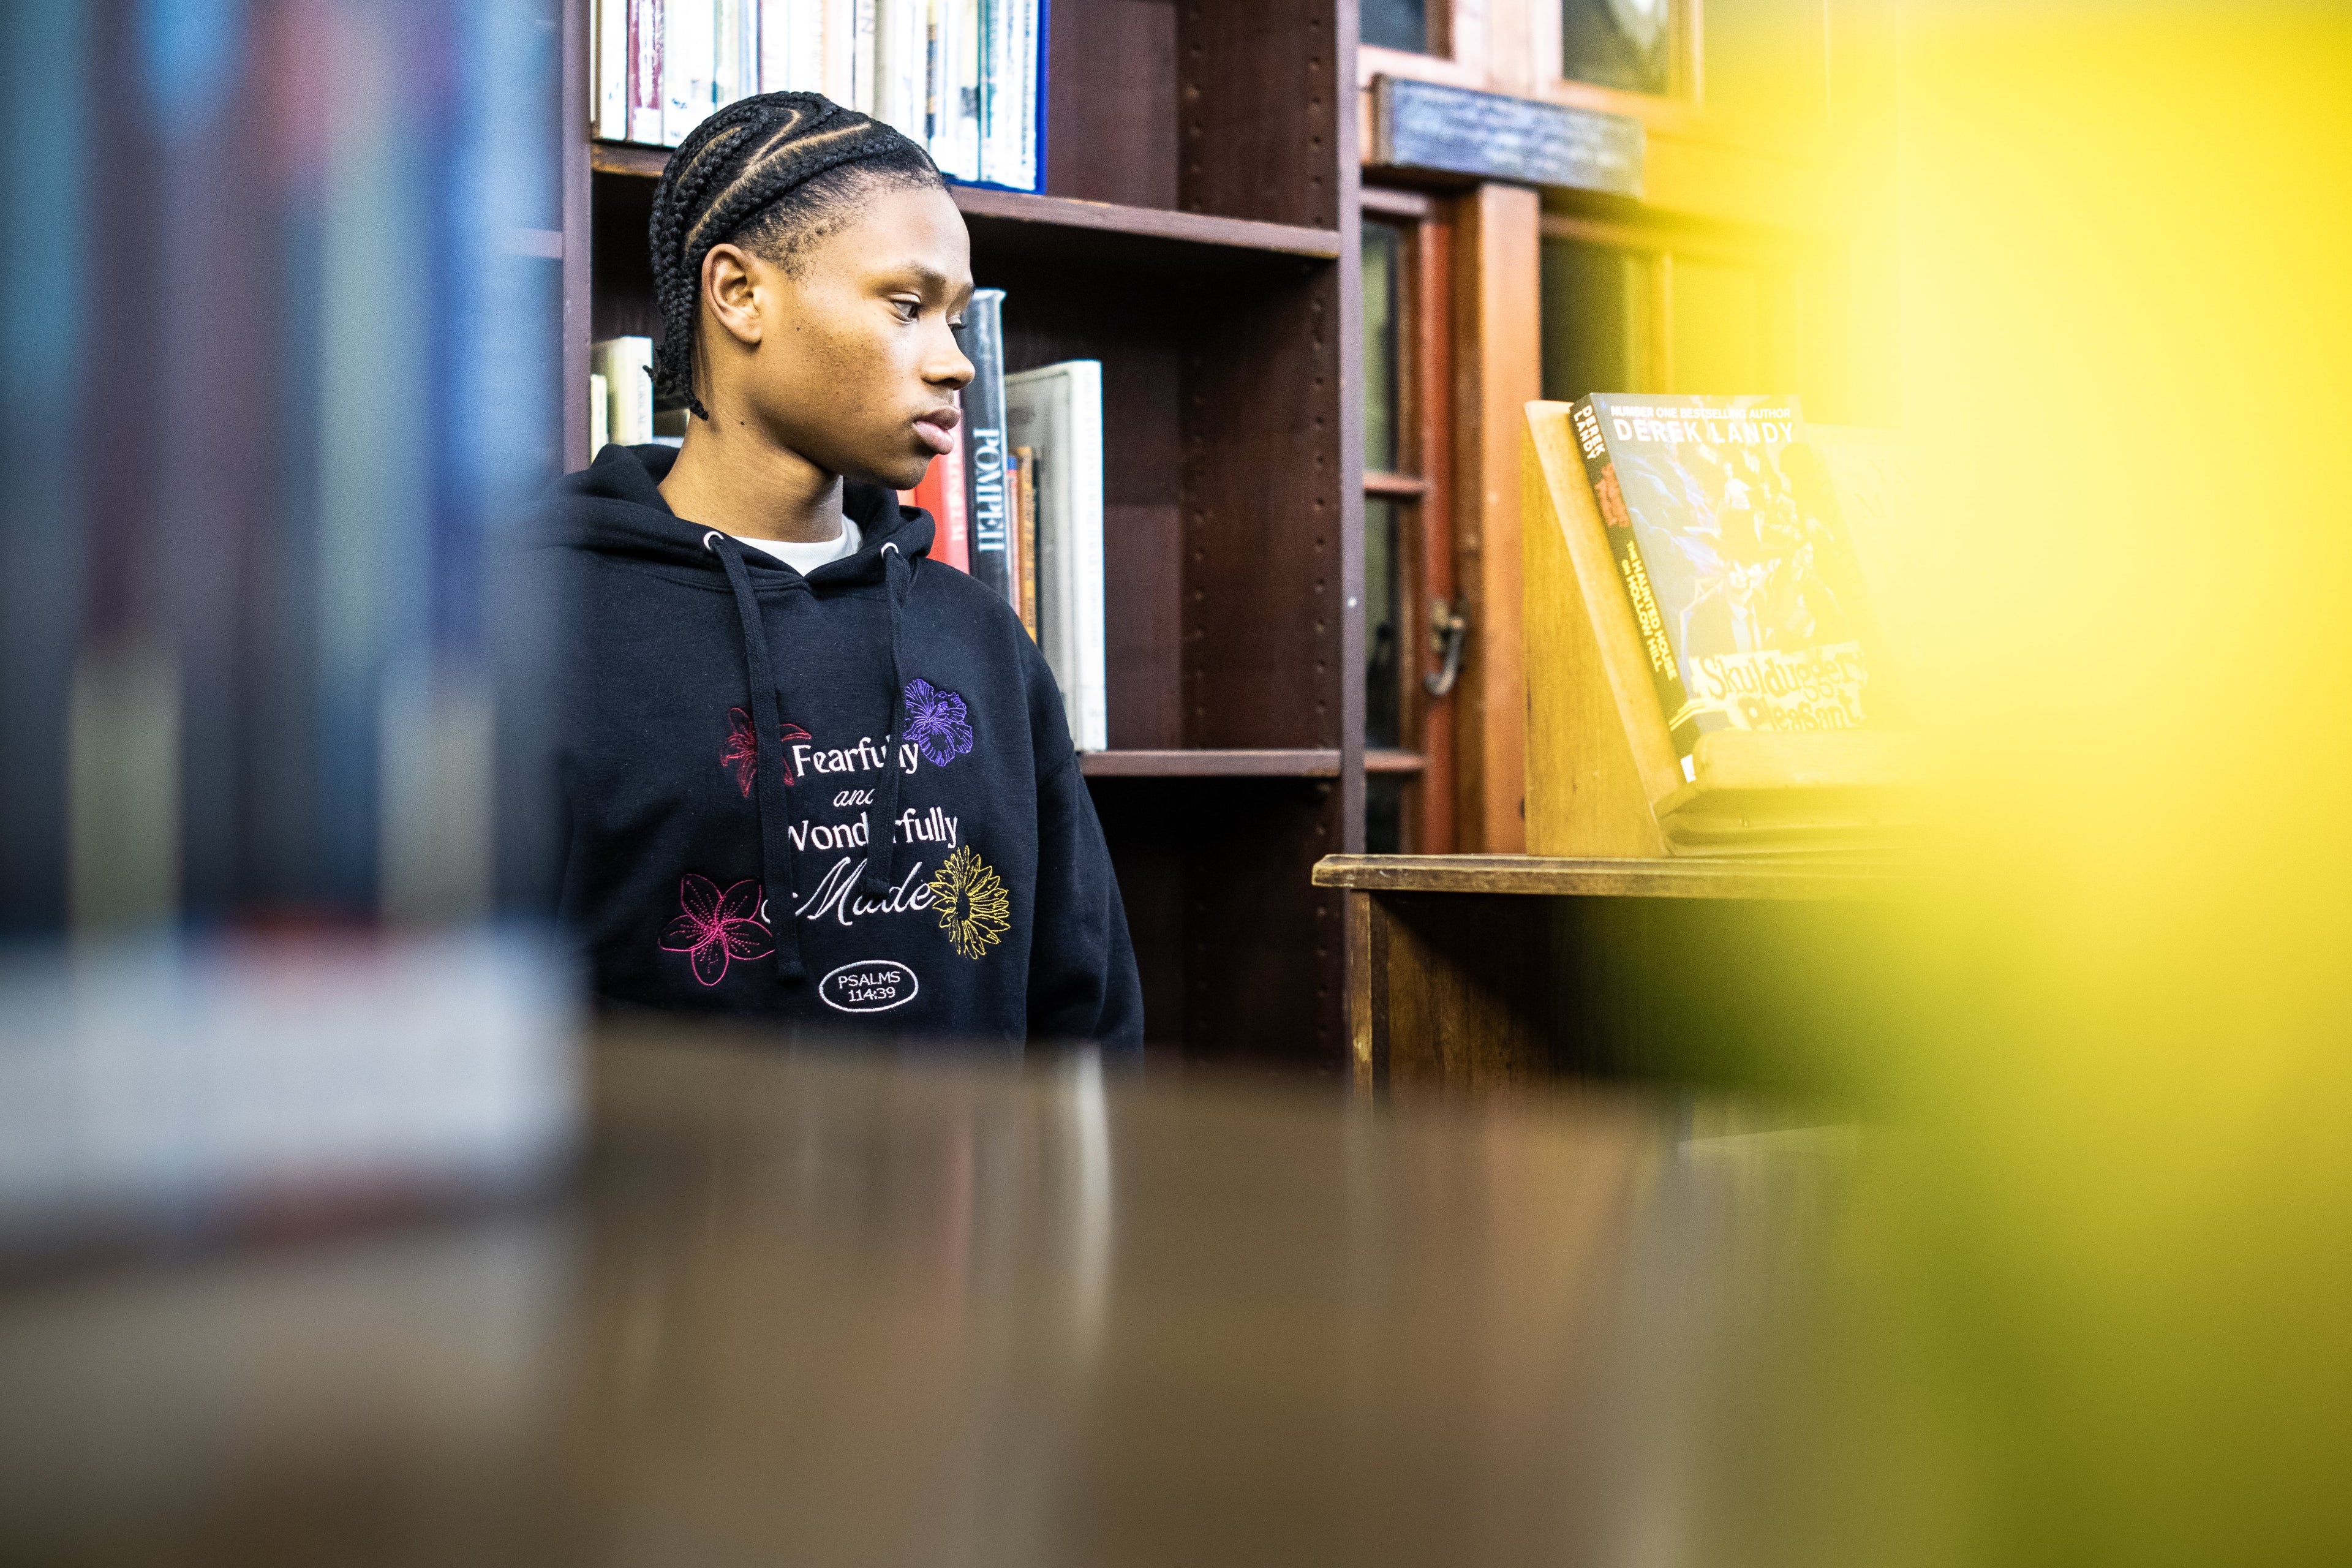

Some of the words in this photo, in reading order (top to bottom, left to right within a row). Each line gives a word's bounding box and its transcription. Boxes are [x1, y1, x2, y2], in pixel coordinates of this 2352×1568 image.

[1574, 410, 1597, 459] LANDY
[1582, 405, 1605, 456] DEREK
[1610, 405, 1654, 418] NUMBER
[1656, 407, 1677, 418] ONE
[1680, 408, 1746, 420] BESTSELLING
[1749, 409, 1791, 419] AUTHOR
[1613, 419, 1702, 443] DEREK
[1709, 421, 1792, 443] LANDY
[973, 428, 1005, 551] POMPEII
[1627, 540, 1638, 560] THE
[1622, 559, 1632, 576] ON
[1627, 574, 1653, 637] HOLLOW
[1647, 638, 1663, 673] HILL
[1632, 560, 1660, 630] HAUNTED
[1654, 629, 1678, 681] HOUSE
[838, 971, 900, 989] PSALMS
[848, 987, 895, 1001] 114:39
